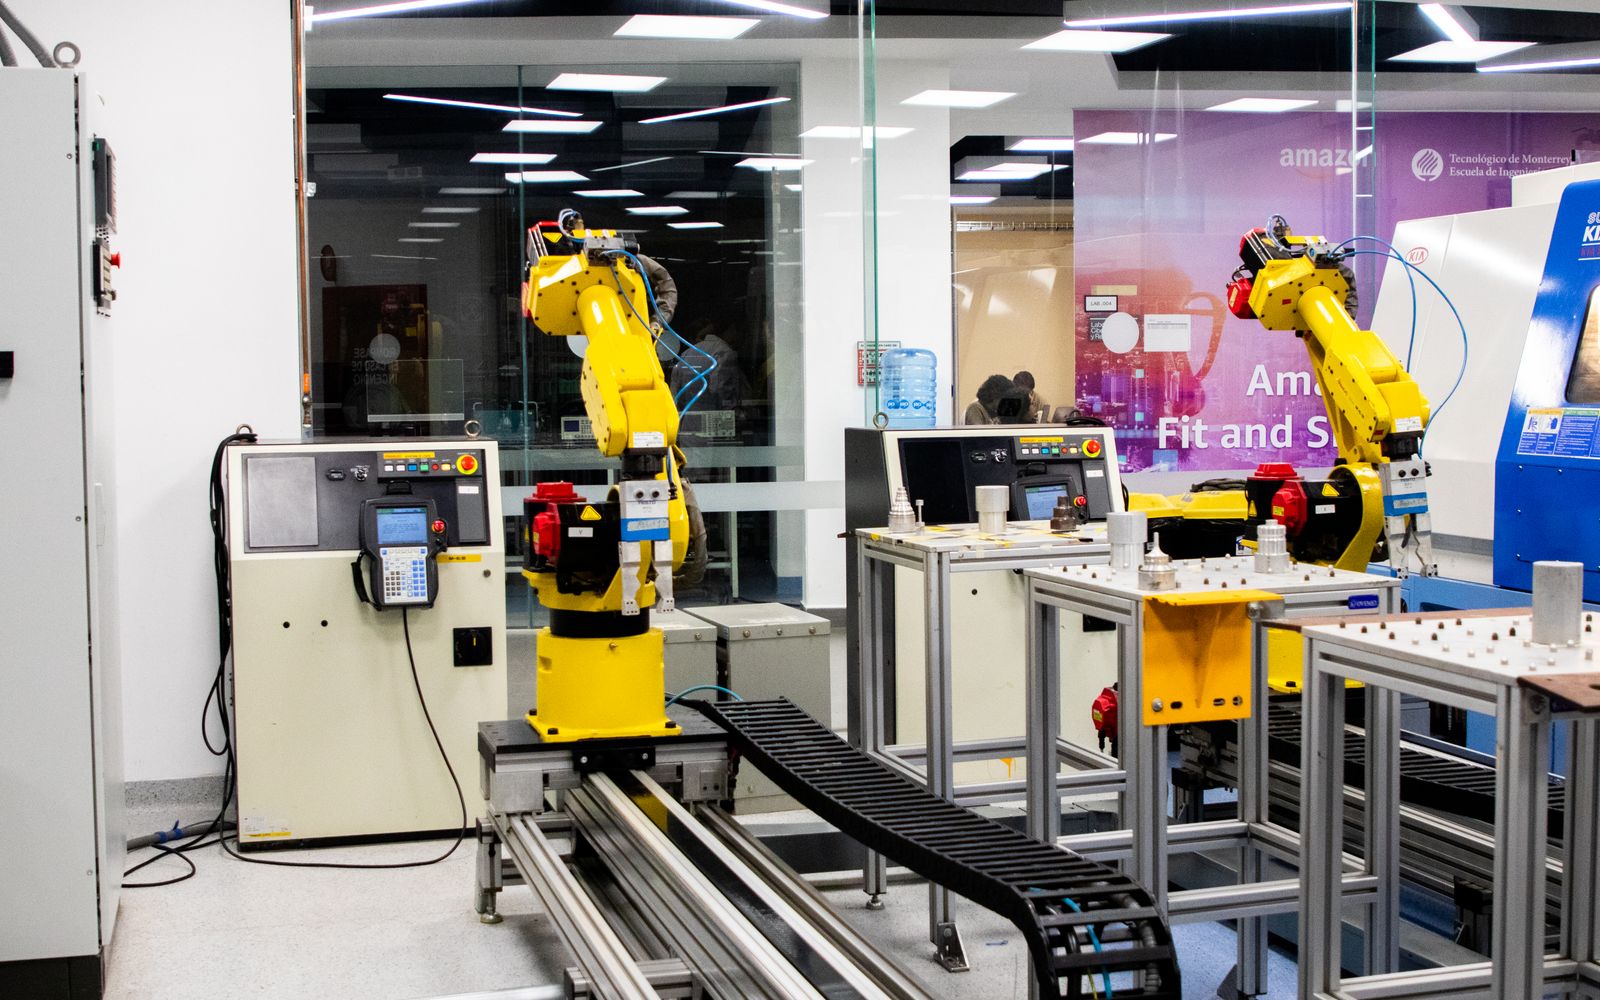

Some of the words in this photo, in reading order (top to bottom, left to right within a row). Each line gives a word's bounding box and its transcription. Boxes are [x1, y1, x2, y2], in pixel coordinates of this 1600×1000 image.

[1449, 153, 1507, 165] Tecnológico
[1508, 153, 1520, 163] de
[1521, 154, 1571, 165] Monterrey
[1449, 167, 1484, 176] Escuela
[1485, 167, 1497, 176] de
[1582, 225, 1600, 242] KI
[1246, 364, 1322, 396] Am
[1158, 415, 1209, 449] Fit
[1220, 414, 1294, 449] and
[1306, 416, 1339, 449] S
